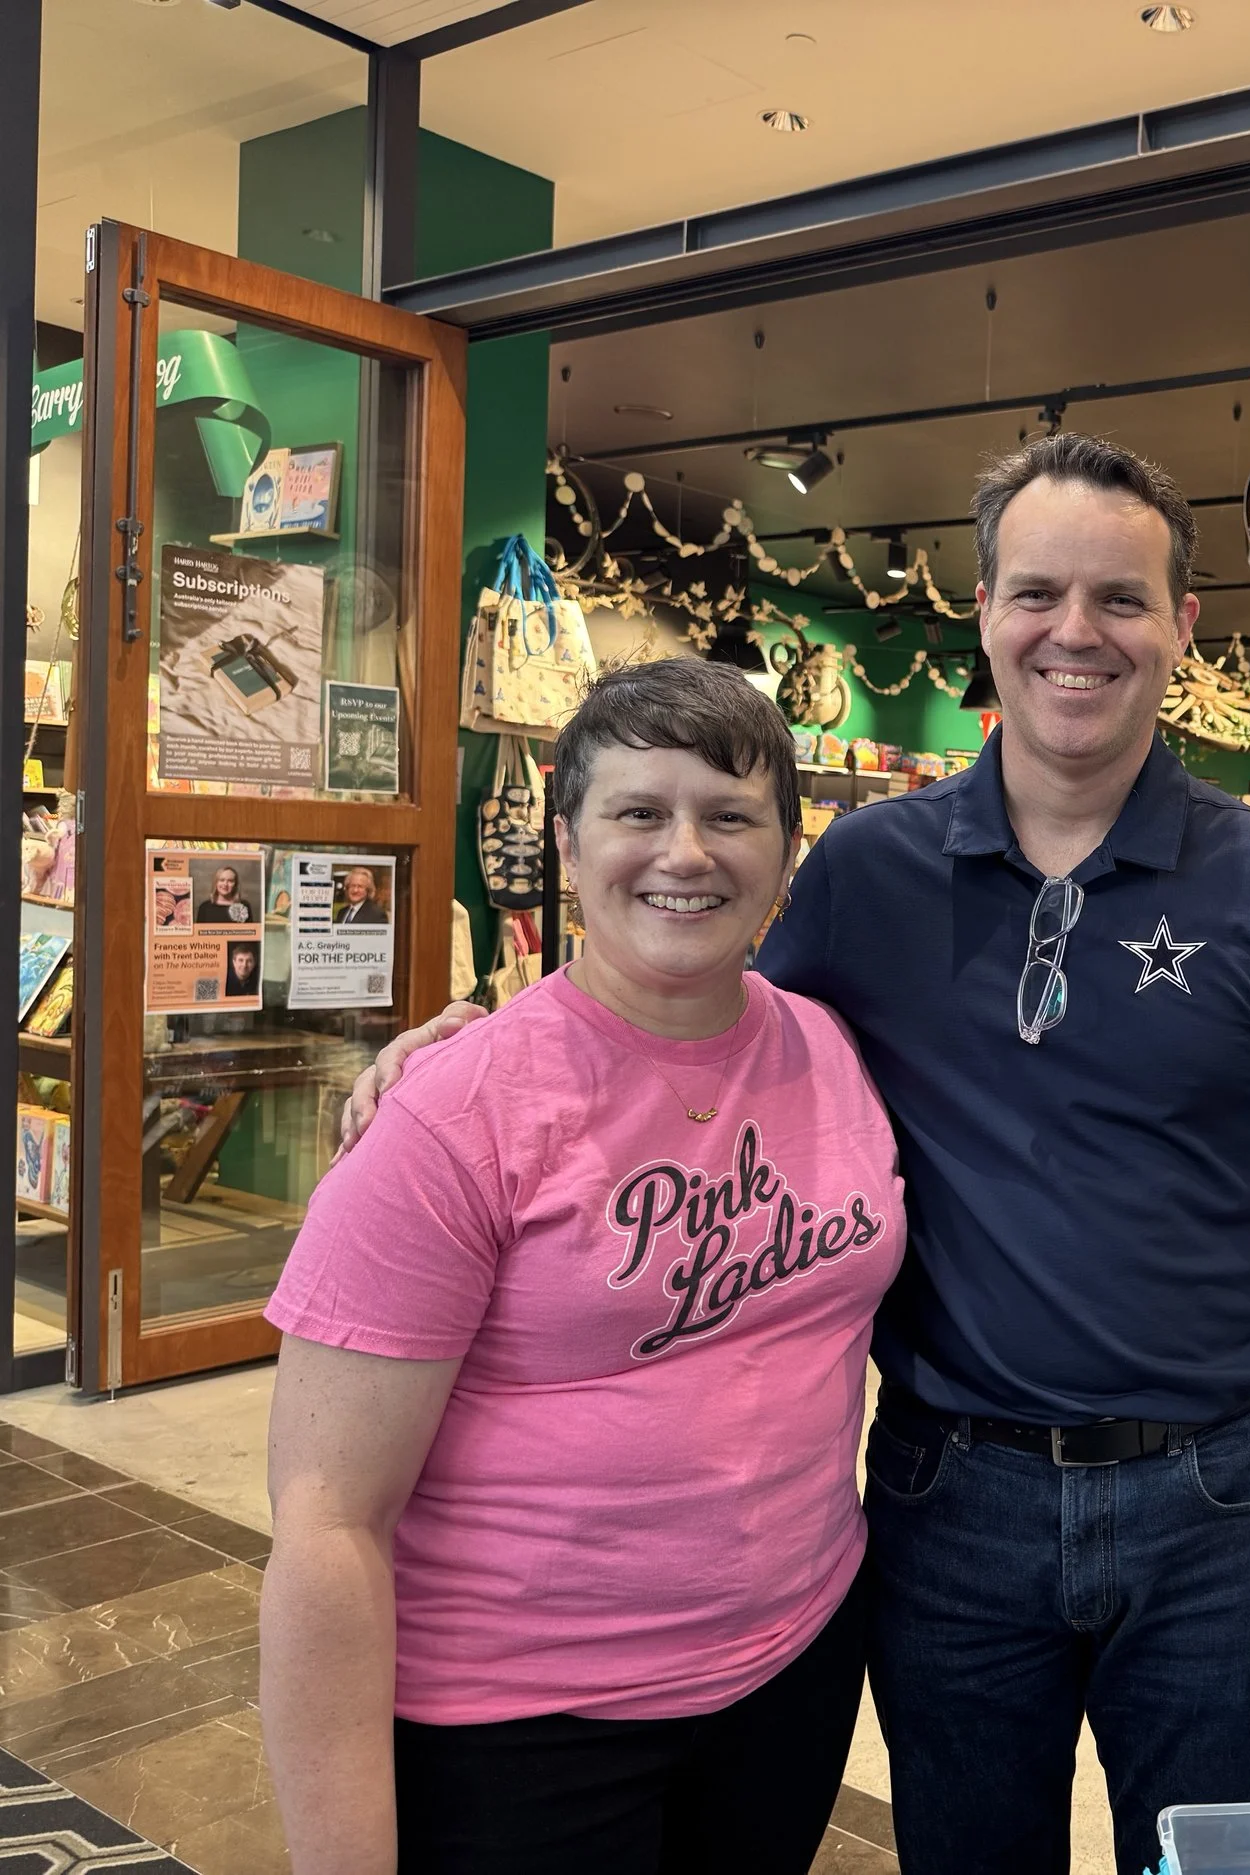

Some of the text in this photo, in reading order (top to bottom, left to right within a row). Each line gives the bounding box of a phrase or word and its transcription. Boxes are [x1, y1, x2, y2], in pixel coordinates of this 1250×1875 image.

[173, 571, 291, 603] Subscriptions
[340, 697, 364, 707] RSVP
[332, 710, 368, 722] Upcoming
[154, 942, 221, 951] Frances Whiting
[317, 941, 351, 951] Grayling
[298, 952, 387, 964] FOR THE PEOPLE
[180, 961, 220, 969] Nocturnals
[614, 1124, 781, 1281] Pink
[638, 1192, 882, 1355] Ladies
